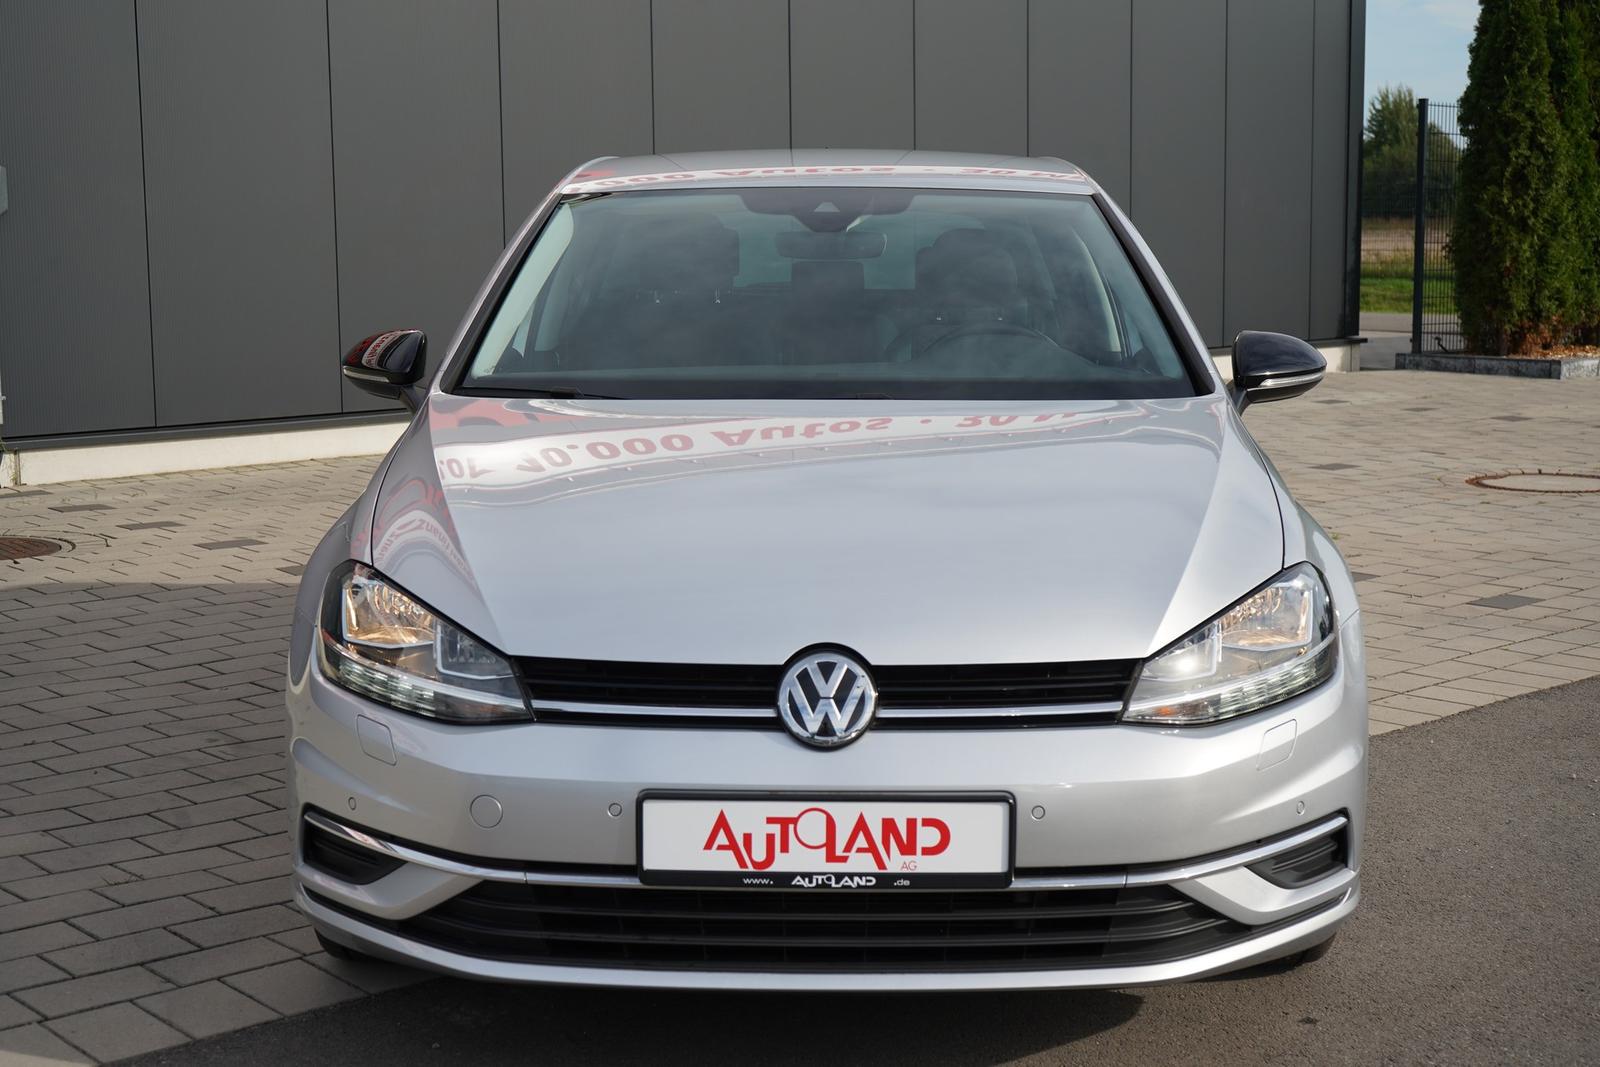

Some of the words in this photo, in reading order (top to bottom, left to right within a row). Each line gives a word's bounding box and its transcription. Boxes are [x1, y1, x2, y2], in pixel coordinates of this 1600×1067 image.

[900, 860, 918, 871] AG
[742, 877, 774, 885] www.
[893, 878, 911, 886] .de
